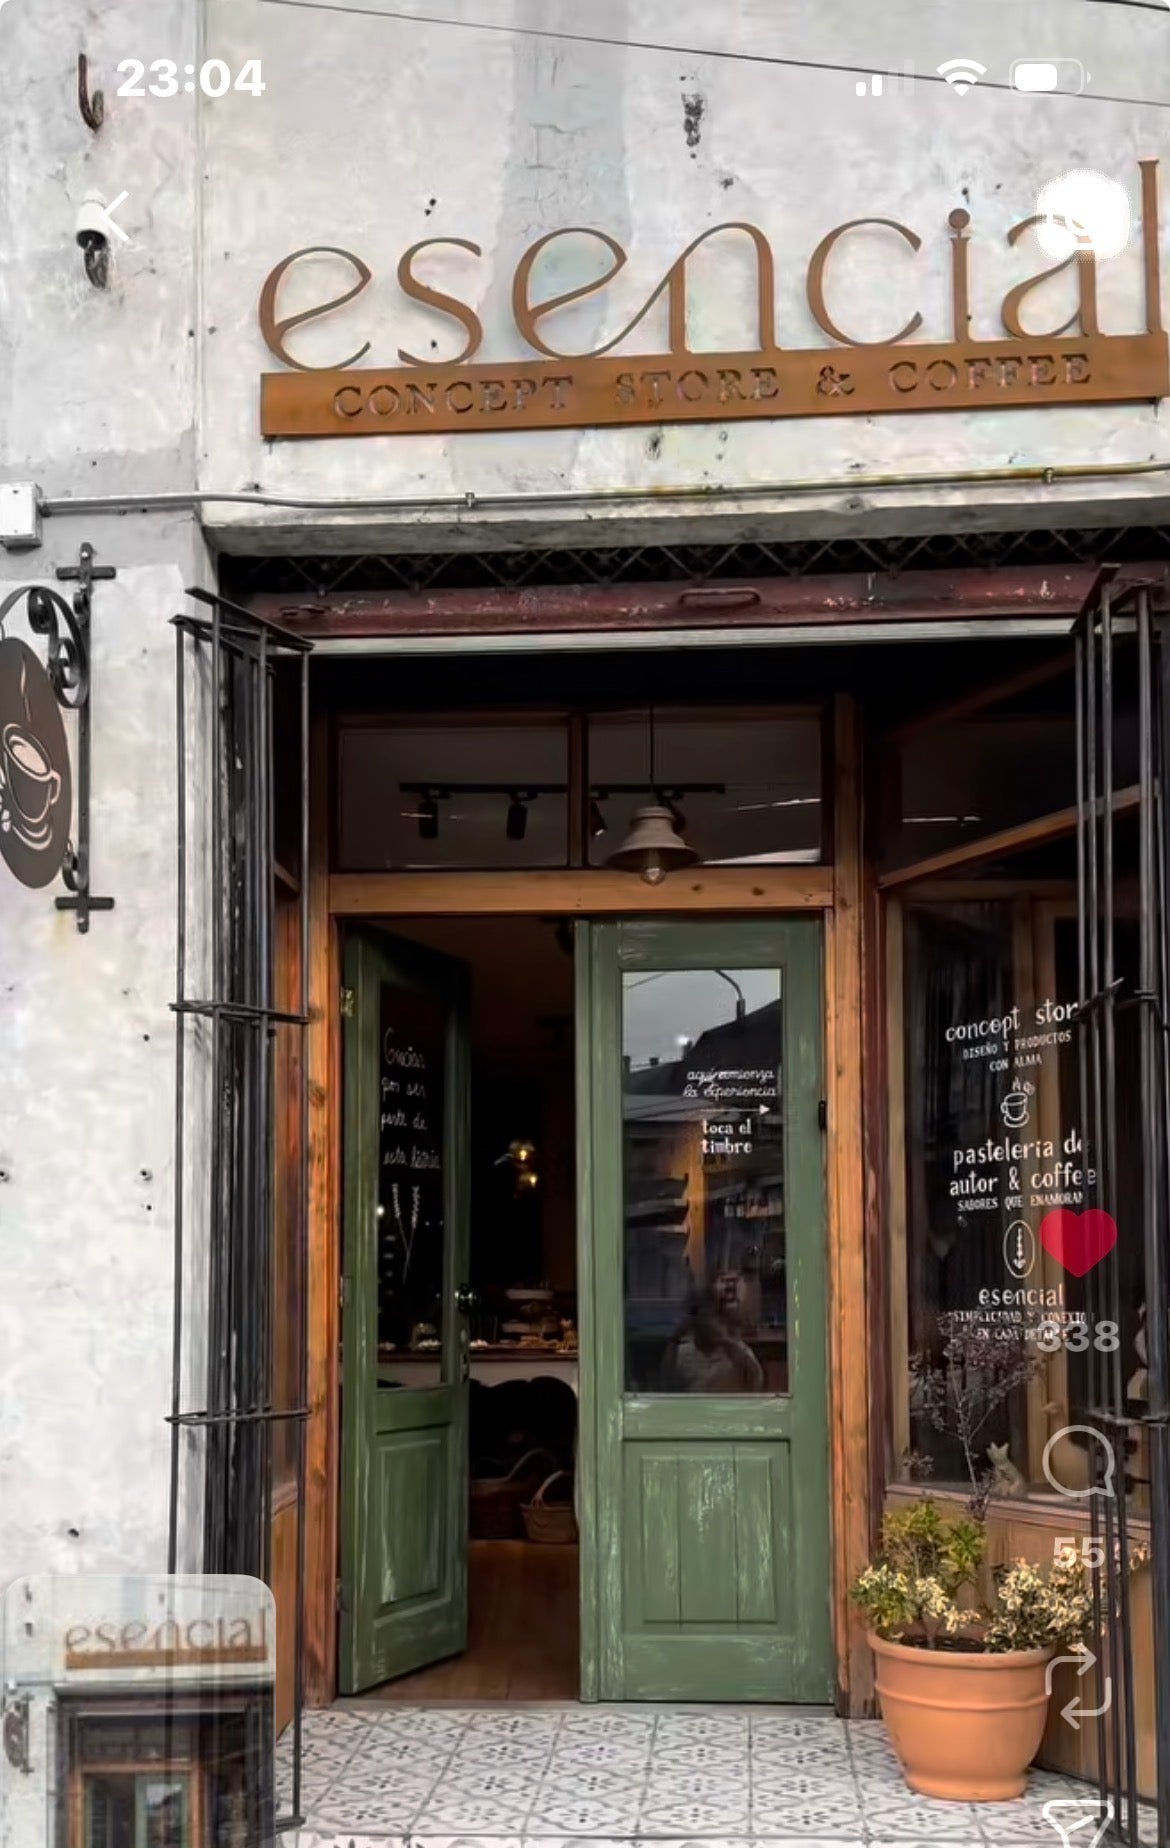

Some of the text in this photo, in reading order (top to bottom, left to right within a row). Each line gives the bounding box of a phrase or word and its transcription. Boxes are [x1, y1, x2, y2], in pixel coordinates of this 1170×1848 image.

[259, 158, 1162, 371] esencial
[333, 353, 1092, 418] CONCEPT STORE & COFFEE
[945, 998, 1079, 1042] concept stor
[1014, 1030, 1072, 1050] PRODUCTOS
[989, 1053, 1043, 1072] CON ALMA
[702, 1118, 752, 1135] toca el
[701, 1137, 754, 1154] timbre
[950, 1160, 1097, 1197] autor & coffee
[957, 1197, 999, 1212] SABORES
[1004, 1194, 1025, 1211] QUE
[978, 1283, 1064, 1307] esencial
